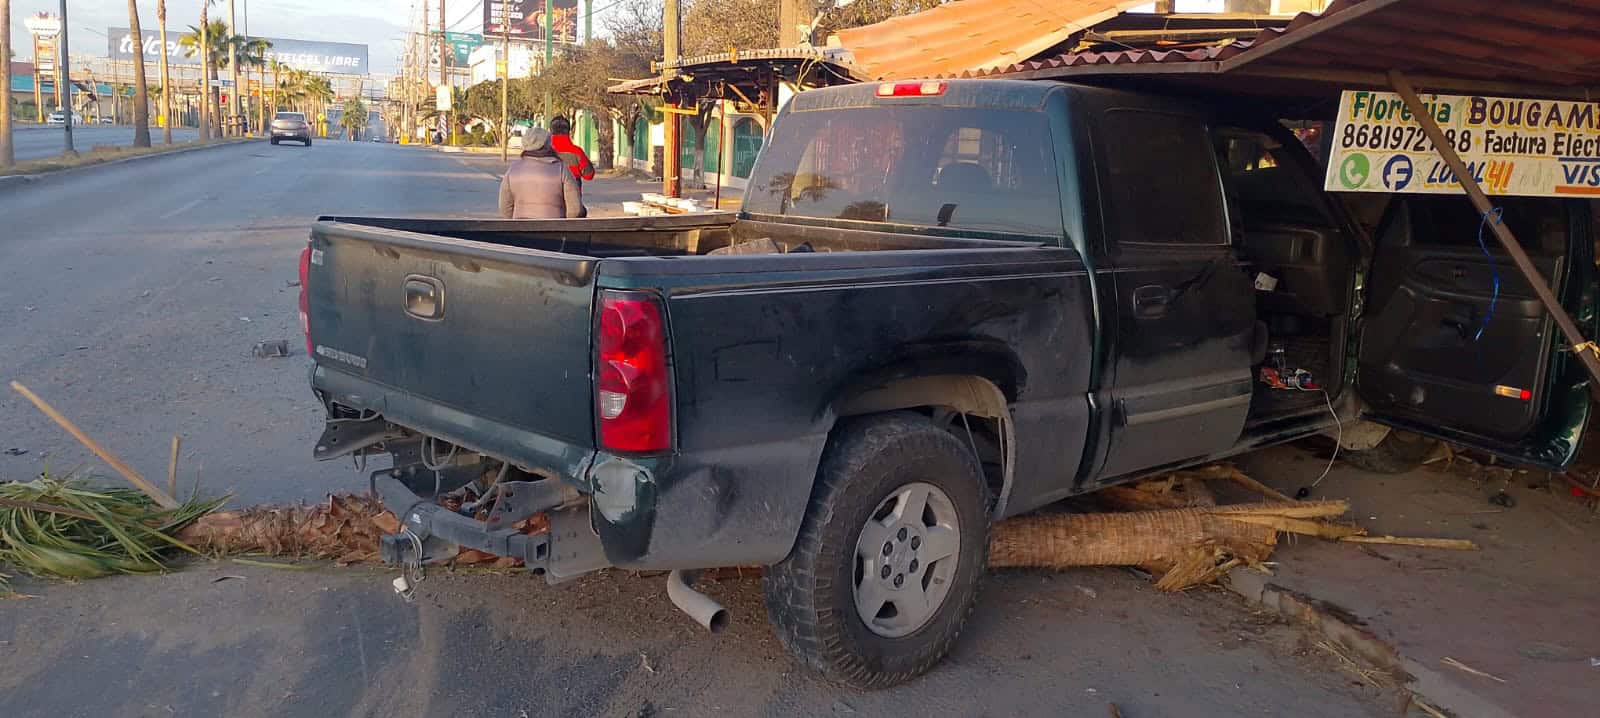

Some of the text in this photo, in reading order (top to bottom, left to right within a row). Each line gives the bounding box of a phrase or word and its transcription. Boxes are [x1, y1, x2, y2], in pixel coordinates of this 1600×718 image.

[324, 55, 361, 68] LIBRE
[1341, 123, 1471, 153] 868197288
[1484, 130, 1546, 154] Factura
[1488, 160, 1515, 189] 41
